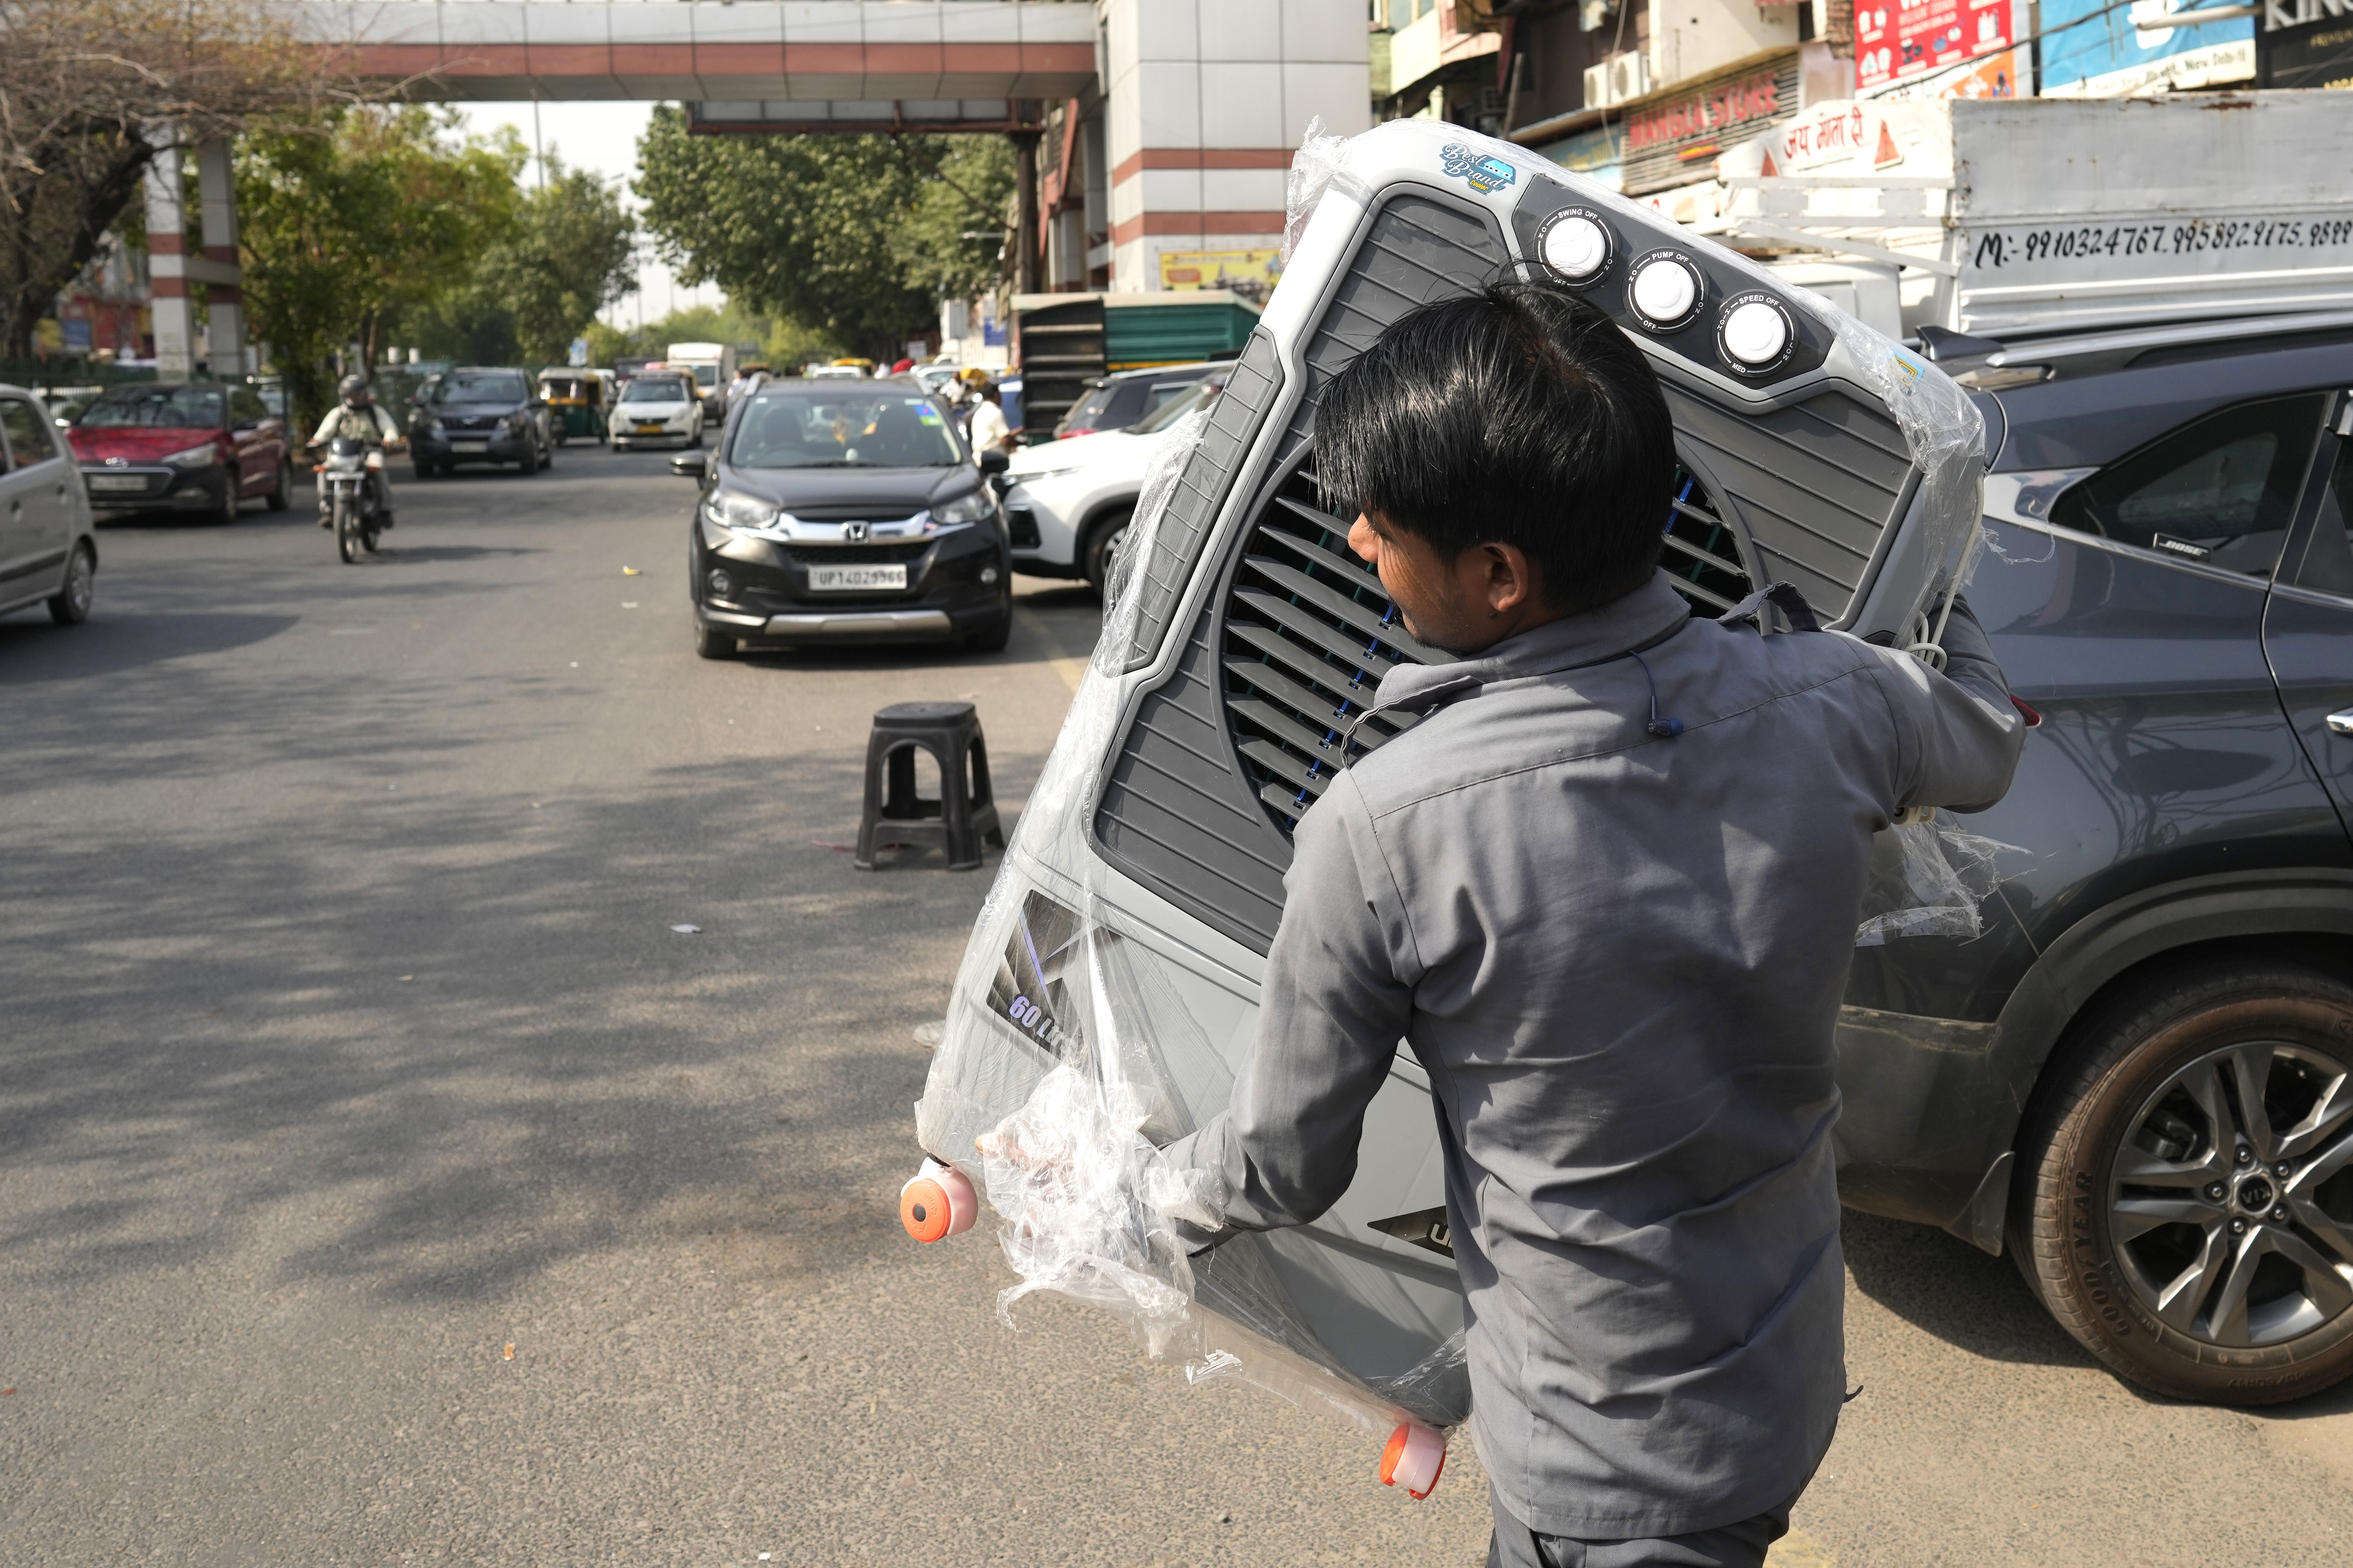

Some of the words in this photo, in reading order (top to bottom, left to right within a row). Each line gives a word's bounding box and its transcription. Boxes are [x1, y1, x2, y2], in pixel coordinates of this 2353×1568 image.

[1784, 125, 1810, 159] जय
[1817, 114, 1846, 150] माता
[1443, 144, 1488, 166] Best
[1446, 159, 1505, 188] Brand
[1558, 209, 1582, 218] SWING
[1585, 211, 1598, 220] OFF
[1538, 227, 1547, 239] ON
[1652, 251, 1674, 260] PUMP
[1676, 254, 1689, 263] OFF
[1604, 259, 1613, 271] ON
[1553, 277, 1566, 286] OFF
[1628, 269, 1637, 282] ON
[1739, 295, 1764, 304] SPEED
[1766, 297, 1779, 306] OFF
[1695, 302, 1704, 314] ON
[1643, 320, 1657, 330] OFF
[1717, 308, 1731, 331] HIGH
[1782, 342, 1793, 361] LOW
[1732, 363, 1746, 373] MED
[2159, 540, 2208, 556] BOSE
[1009, 996, 1042, 1028] 60
